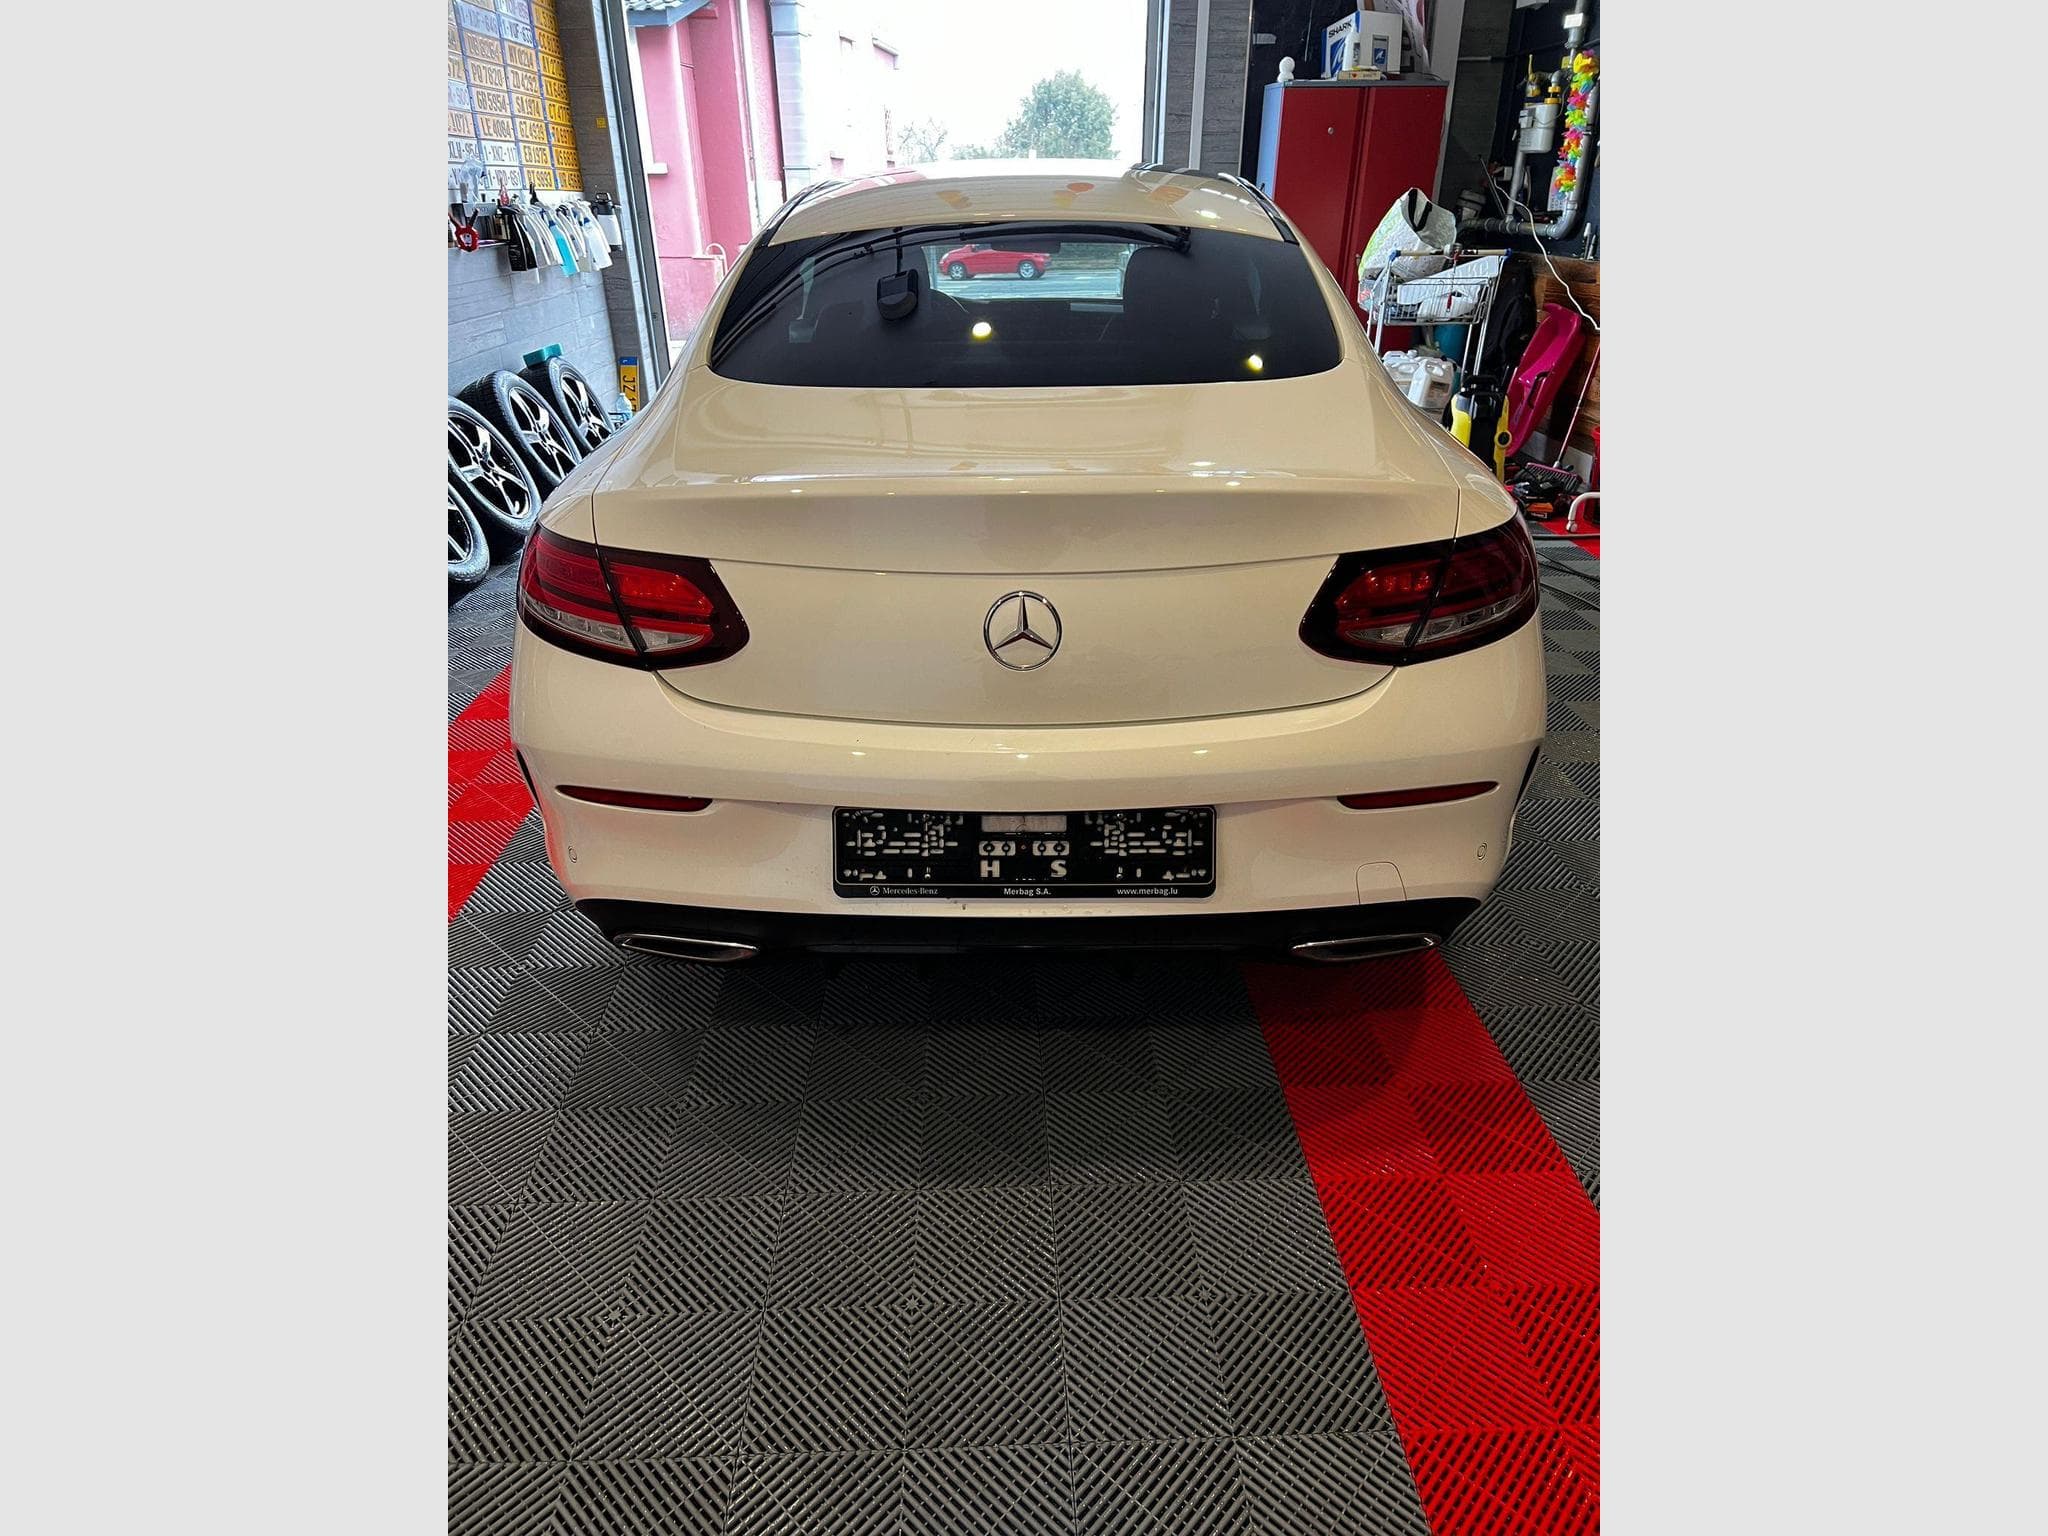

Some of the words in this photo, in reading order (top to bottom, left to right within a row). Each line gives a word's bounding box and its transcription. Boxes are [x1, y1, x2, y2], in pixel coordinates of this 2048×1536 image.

[1328, 20, 1352, 38] SHARK
[980, 860, 1000, 878] H
[1051, 860, 1067, 878] S
[882, 887, 938, 895] Mercedes-Benz
[1004, 888, 1034, 897] Merbag
[1116, 887, 1179, 897] www.merbag.lu
